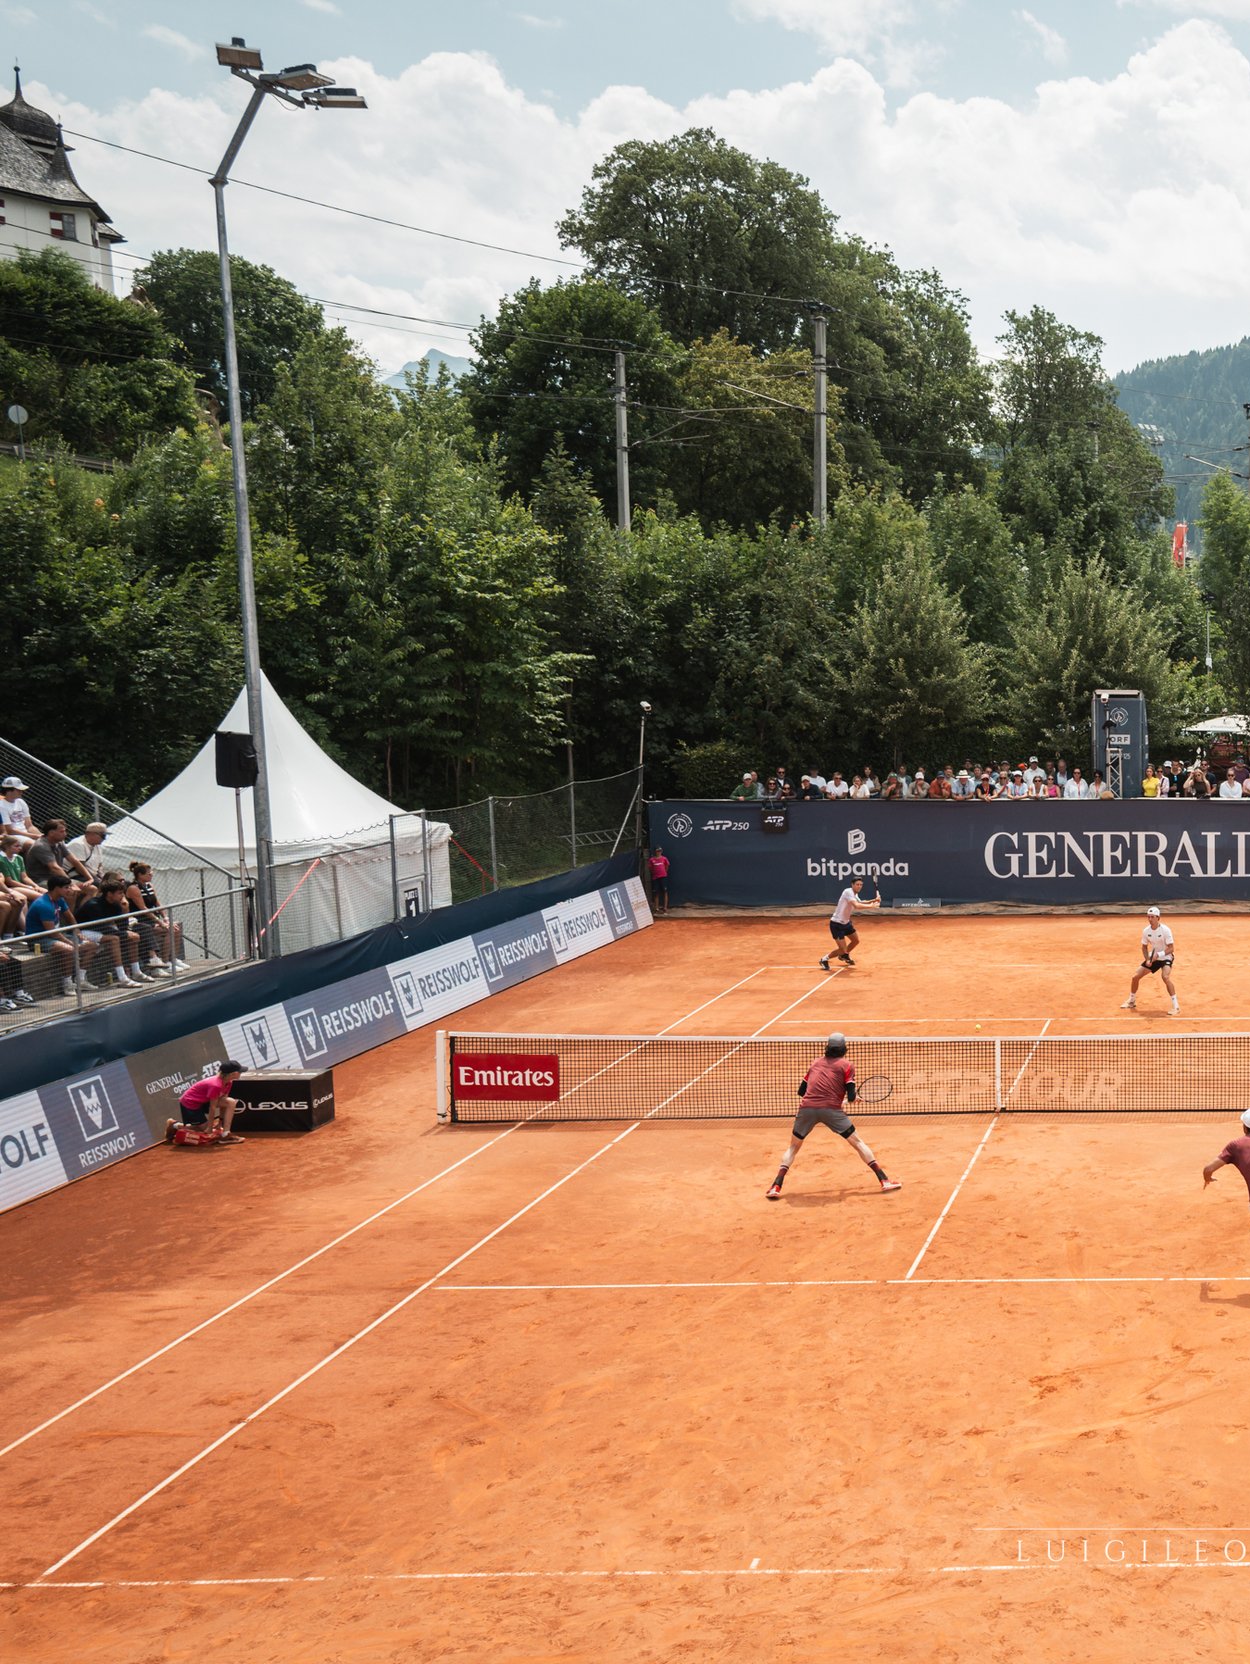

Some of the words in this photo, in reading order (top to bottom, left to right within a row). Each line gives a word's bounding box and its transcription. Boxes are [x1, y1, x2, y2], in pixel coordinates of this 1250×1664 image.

[701, 820, 732, 831] ATP
[732, 822, 750, 831] 250
[764, 815, 784, 823] ATP
[806, 857, 909, 881] bitpanda
[563, 907, 607, 940] REISSWOLF
[498, 930, 549, 966] REISSWOLF
[418, 956, 482, 999] REISSWOLF
[321, 990, 395, 1039] REISSWOLF
[145, 1071, 184, 1095] GENERALI
[458, 1066, 555, 1087] Emirates
[247, 1101, 309, 1111] LEXUS
[316, 1093, 334, 1106] LEXUS
[0, 1123, 49, 1173] OLF
[78, 1132, 137, 1168] REISSWOLF
